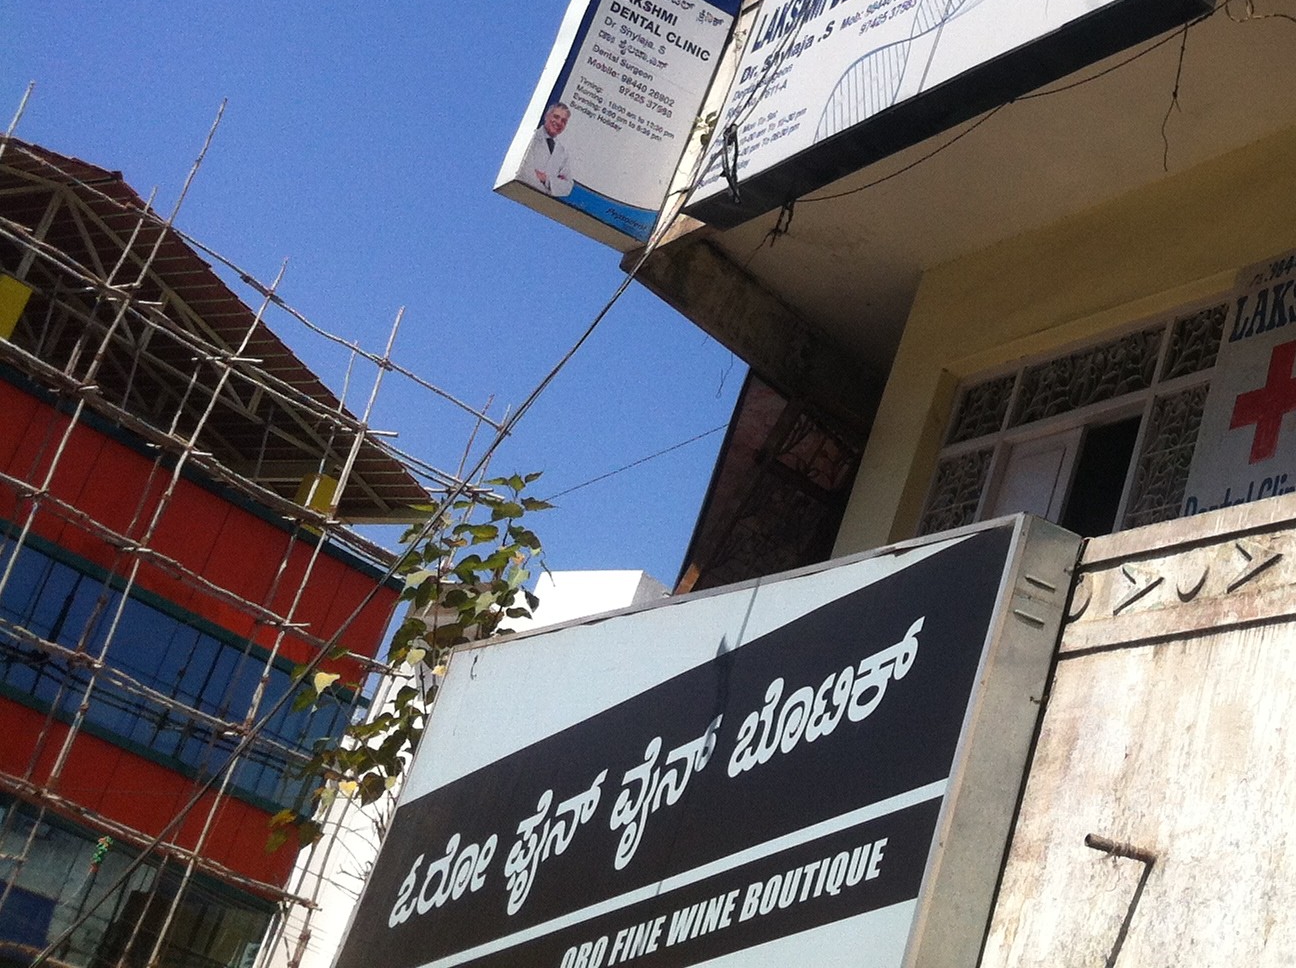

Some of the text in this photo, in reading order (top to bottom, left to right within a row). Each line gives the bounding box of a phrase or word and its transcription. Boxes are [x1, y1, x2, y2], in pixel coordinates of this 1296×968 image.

[610, 1, 661, 37] DENTAL
[666, 32, 711, 62] CLINIC
[607, 915, 667, 968] FINE
[666, 888, 740, 948] WINE
[739, 837, 888, 923] BOUTIQUE
